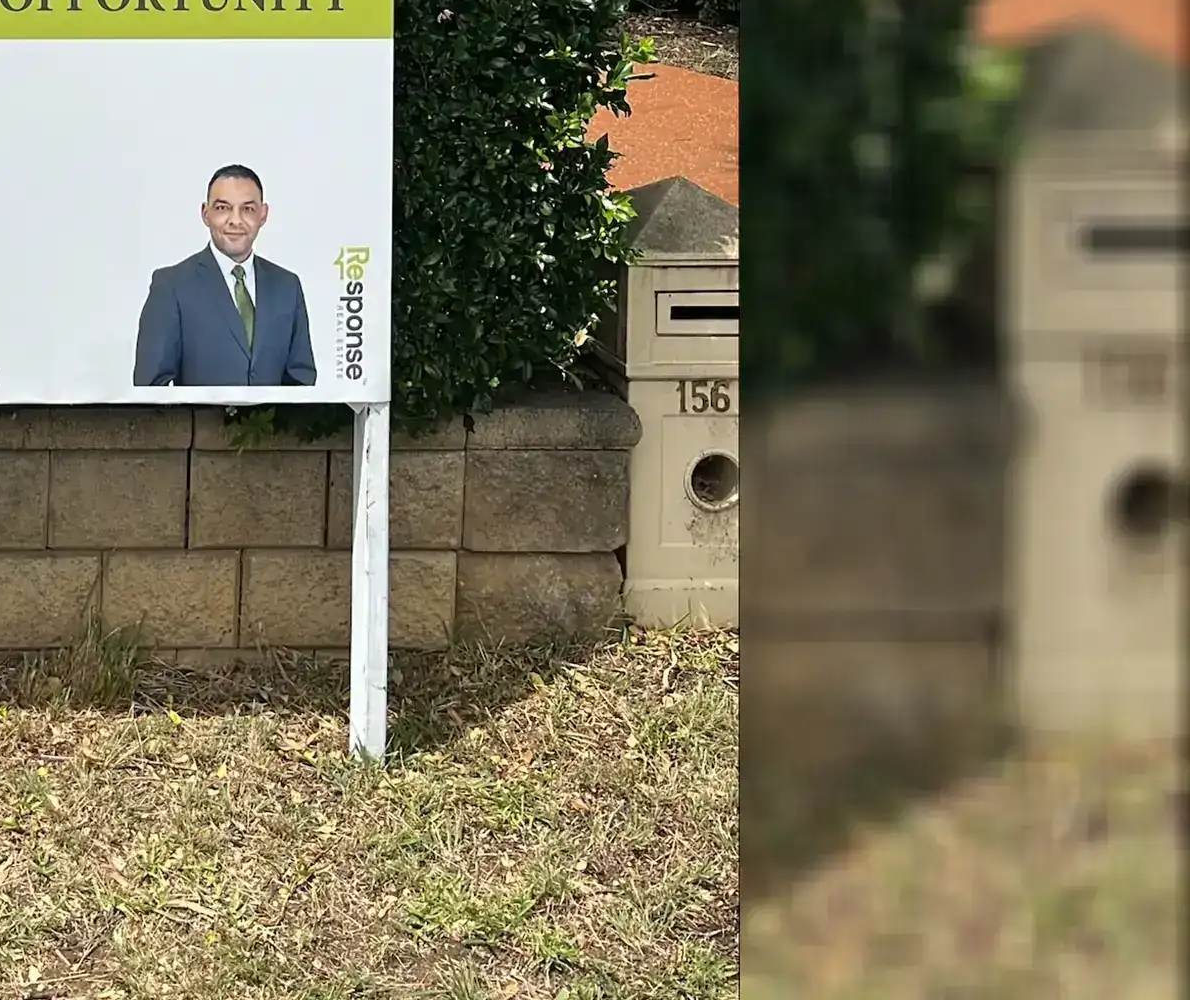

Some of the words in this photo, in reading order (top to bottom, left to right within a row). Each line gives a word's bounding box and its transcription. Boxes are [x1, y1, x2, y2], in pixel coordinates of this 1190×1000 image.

[336, 305, 344, 332] REAL
[340, 247, 370, 380] Response
[336, 339, 344, 379] ESTATE
[676, 380, 731, 414] 156
